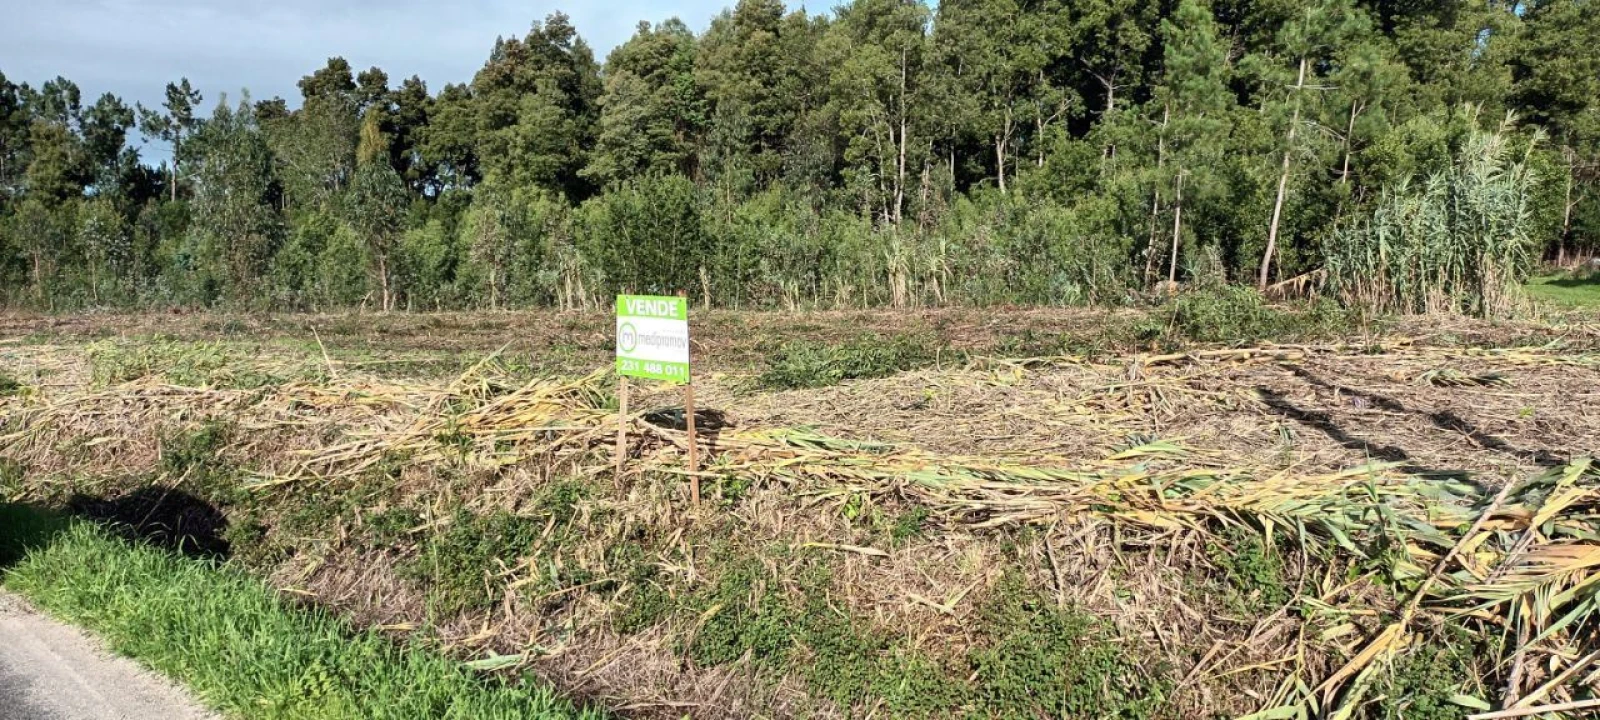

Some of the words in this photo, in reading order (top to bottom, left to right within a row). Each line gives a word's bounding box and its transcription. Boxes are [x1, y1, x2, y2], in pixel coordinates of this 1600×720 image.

[625, 299, 678, 317] VENDE
[621, 359, 638, 371] 231
[643, 362, 663, 374] 488
[665, 364, 685, 376] 011
